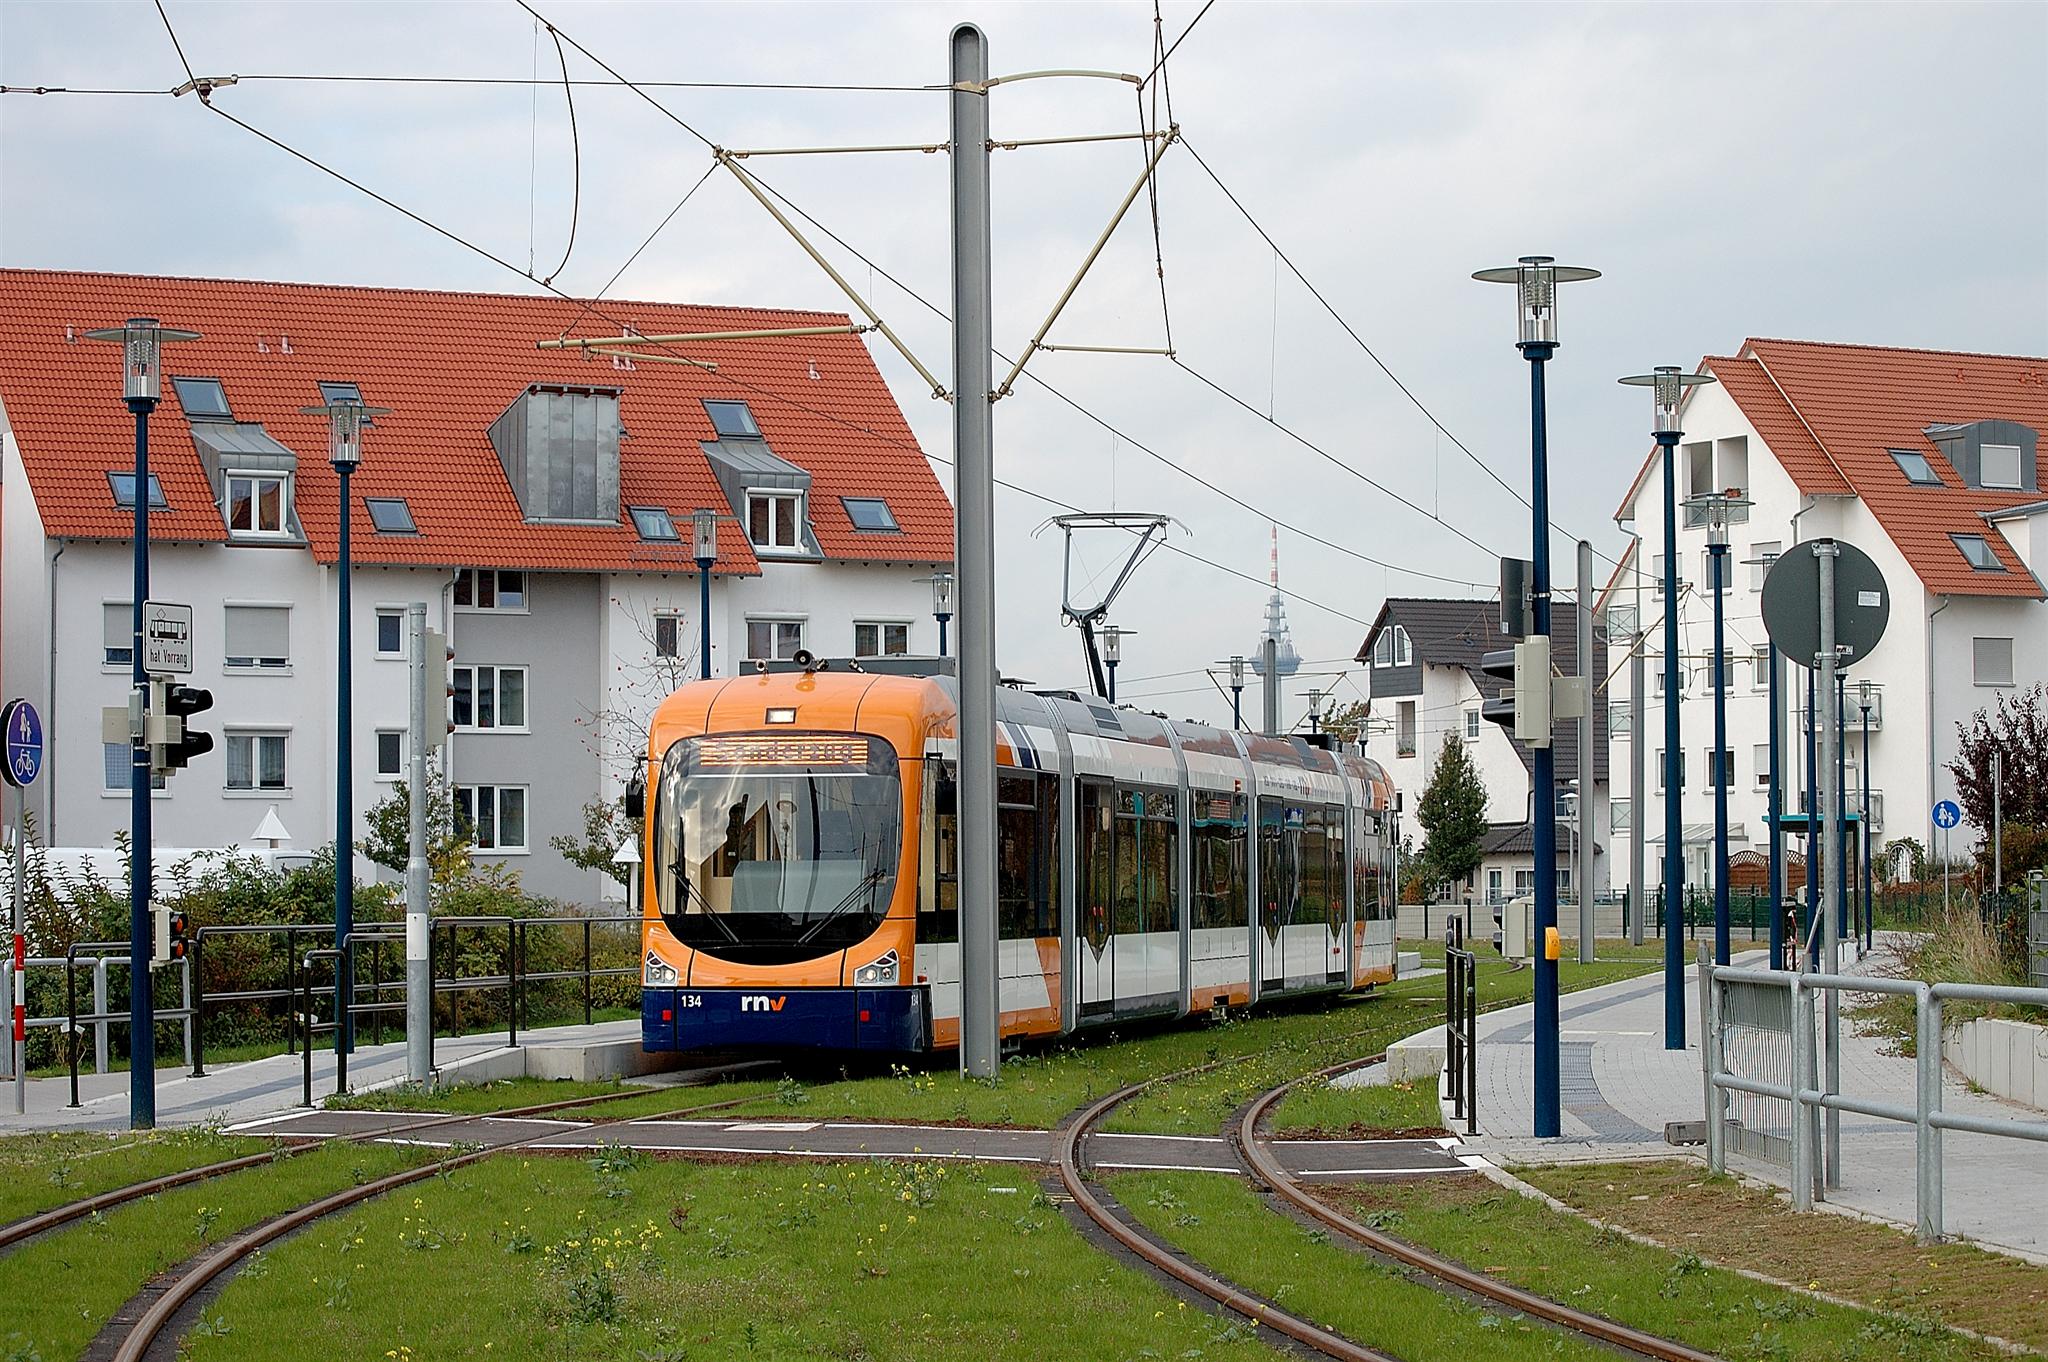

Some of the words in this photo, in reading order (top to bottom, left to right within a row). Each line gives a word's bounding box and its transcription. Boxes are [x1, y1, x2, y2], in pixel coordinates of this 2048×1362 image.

[150, 649, 160, 662] hat
[163, 649, 187, 667] Vorrang
[681, 995, 702, 1008] 134
[741, 995, 786, 1012] rnv
